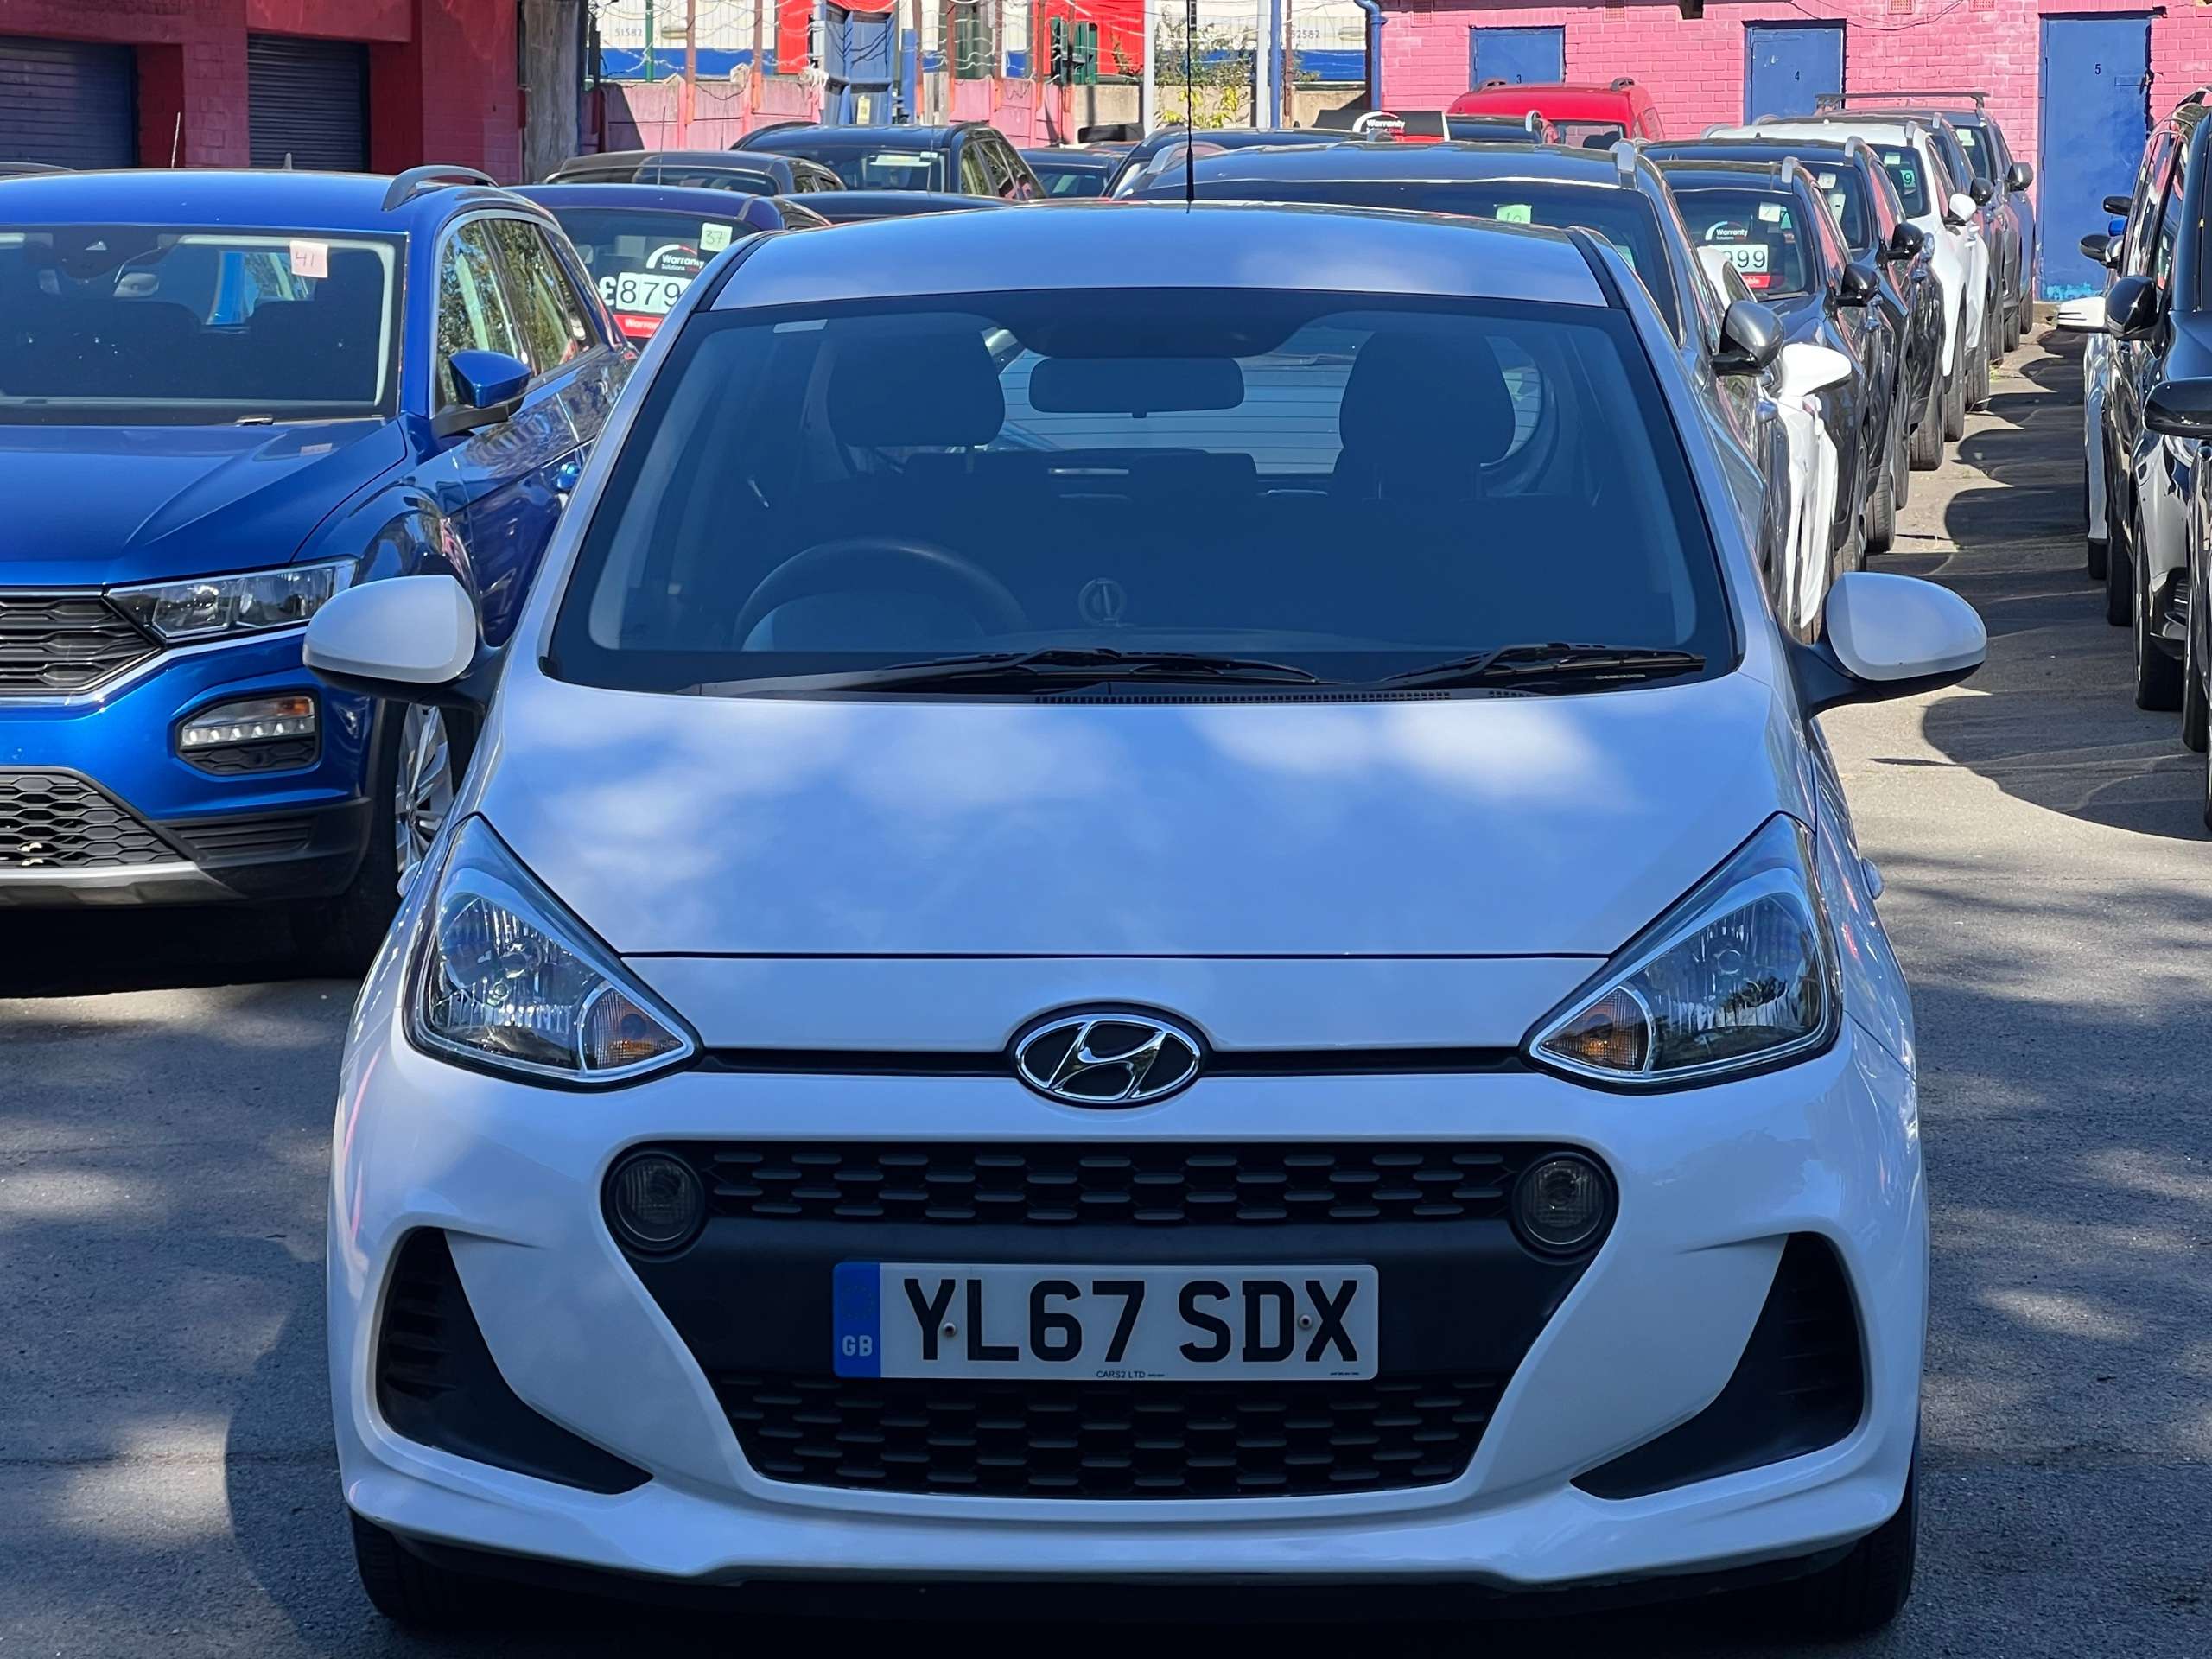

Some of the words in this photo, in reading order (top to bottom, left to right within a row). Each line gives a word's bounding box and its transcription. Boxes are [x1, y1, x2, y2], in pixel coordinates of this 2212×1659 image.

[2094, 63, 2101, 75] 5
[1794, 70, 1800, 81] 4
[1366, 119, 1405, 129] Warranty
[704, 229, 723, 245] 37
[1716, 228, 1748, 237] Warranty
[662, 254, 704, 269] Warranty
[904, 1279, 1146, 1363] YL67
[1178, 1280, 1358, 1363] SDX
[842, 1334, 873, 1357] GB
[1128, 1370, 1146, 1379] LTD
